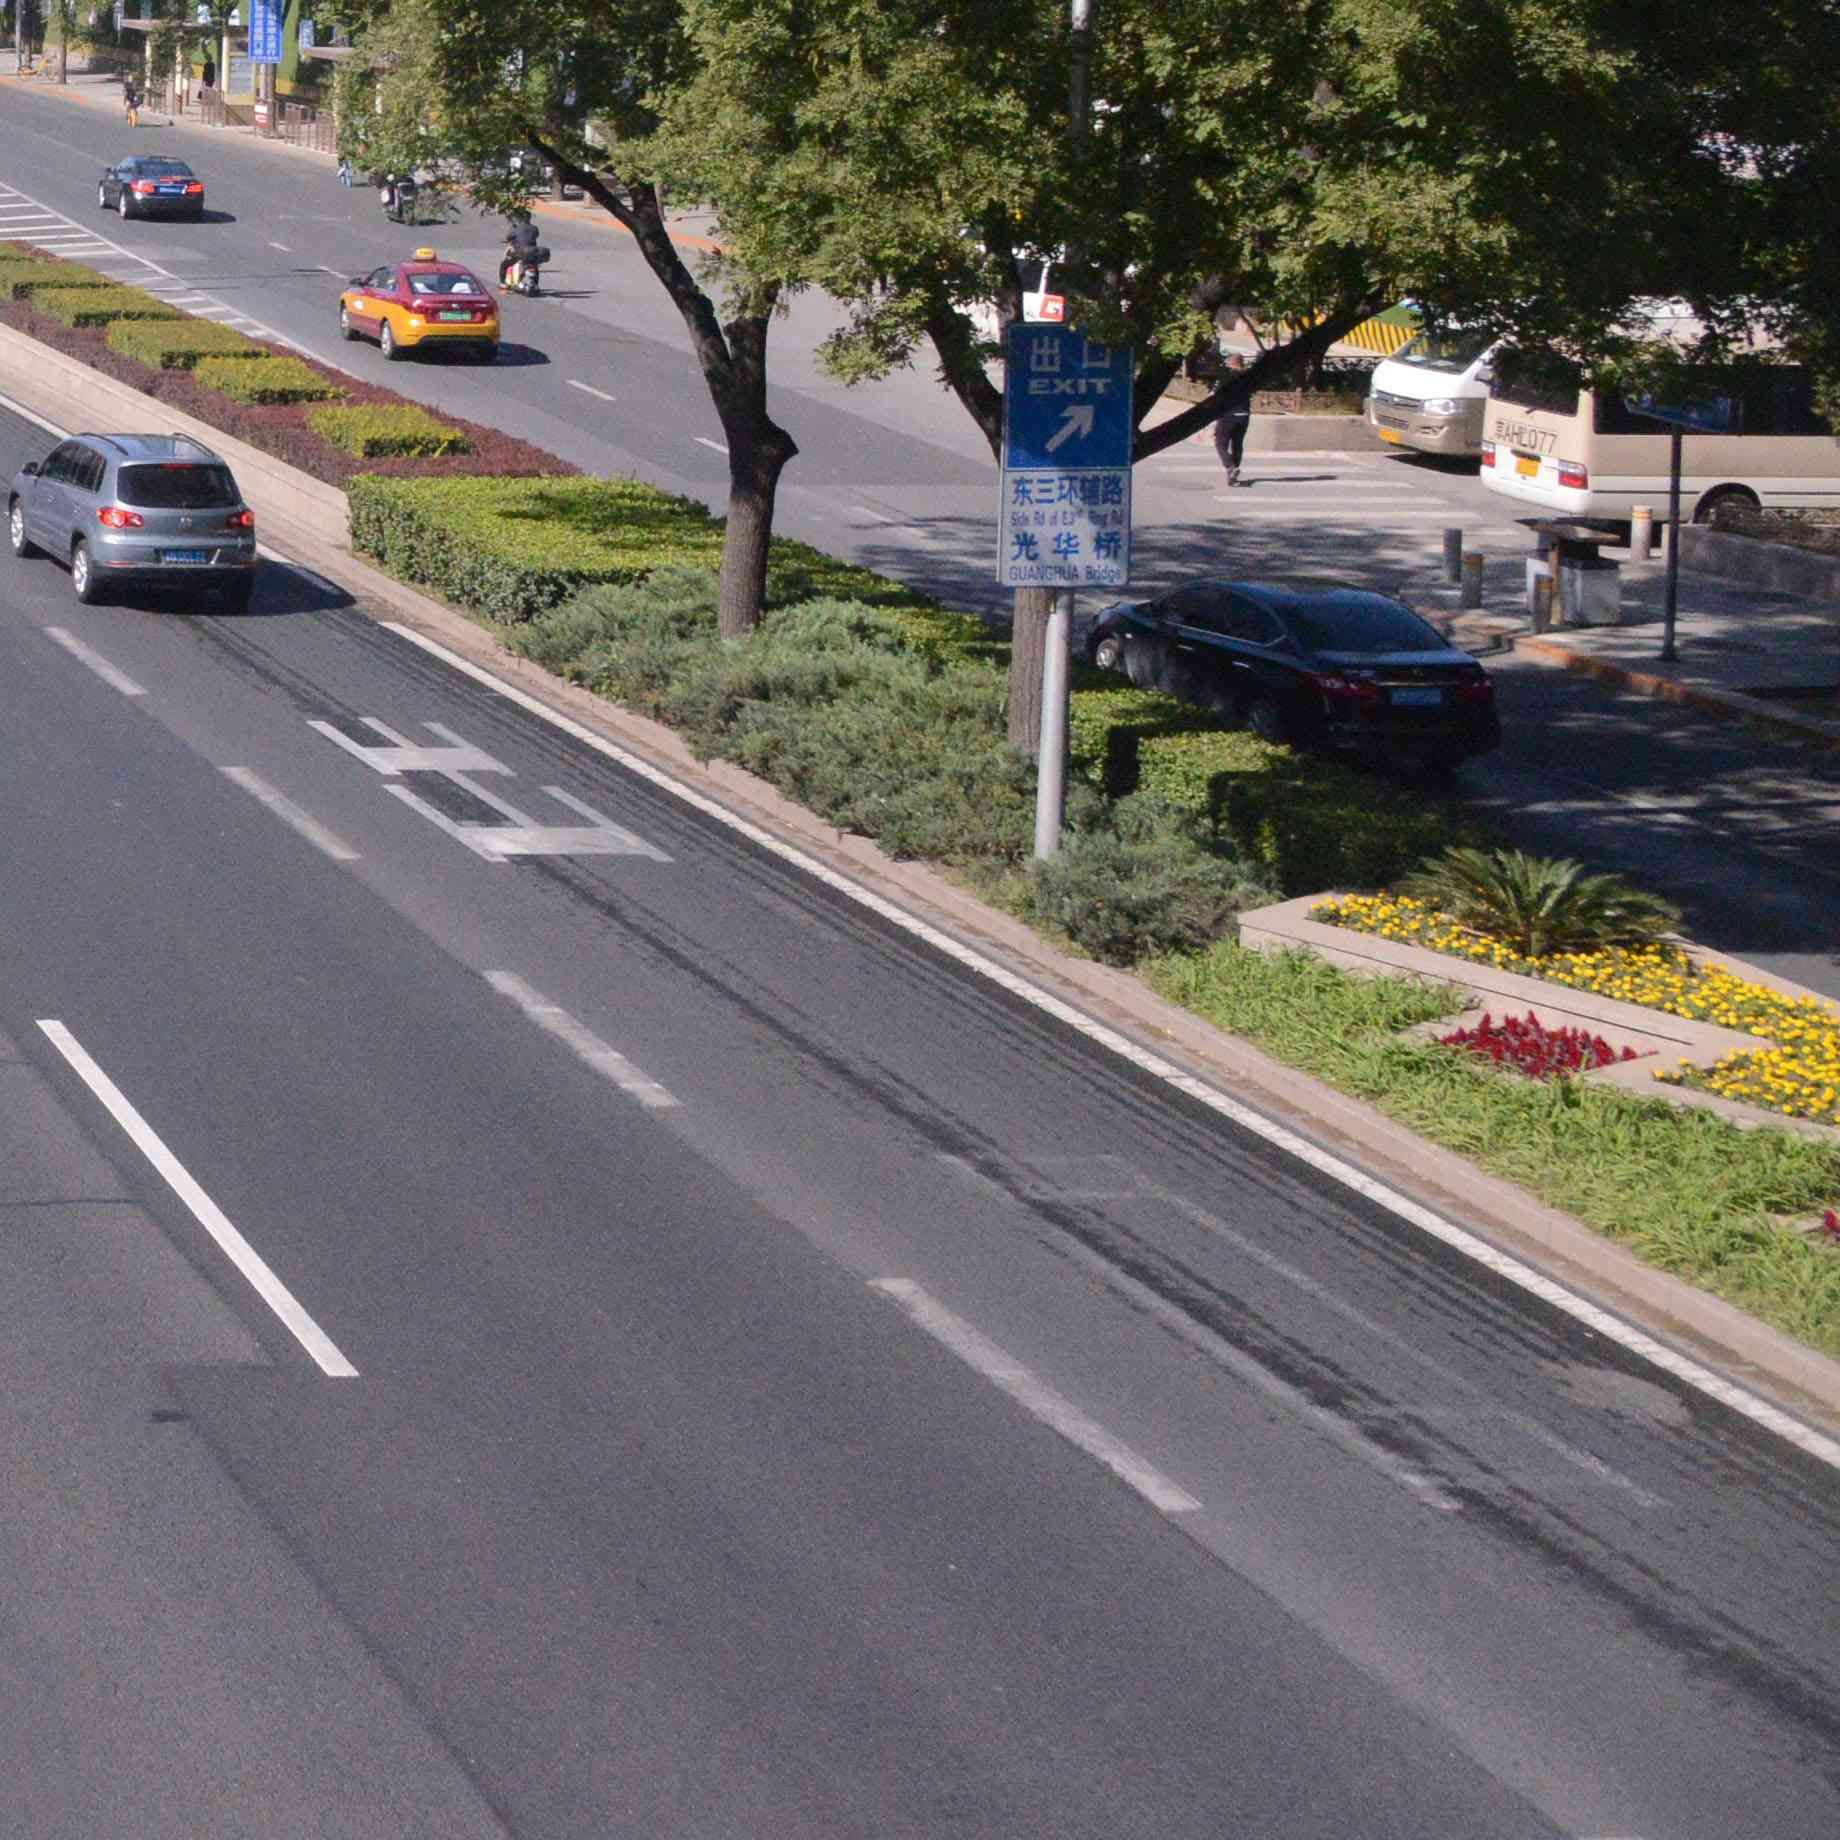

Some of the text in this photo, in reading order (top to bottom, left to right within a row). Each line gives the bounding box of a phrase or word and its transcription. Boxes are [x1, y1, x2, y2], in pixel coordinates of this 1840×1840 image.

[1029, 335, 1112, 373] 出口
[1028, 377, 1113, 396] EXIT
[1011, 475, 1123, 506] 东三环辅路
[1010, 530, 1122, 562] 光华桥
[1008, 565, 1080, 582] GUANGHUA
